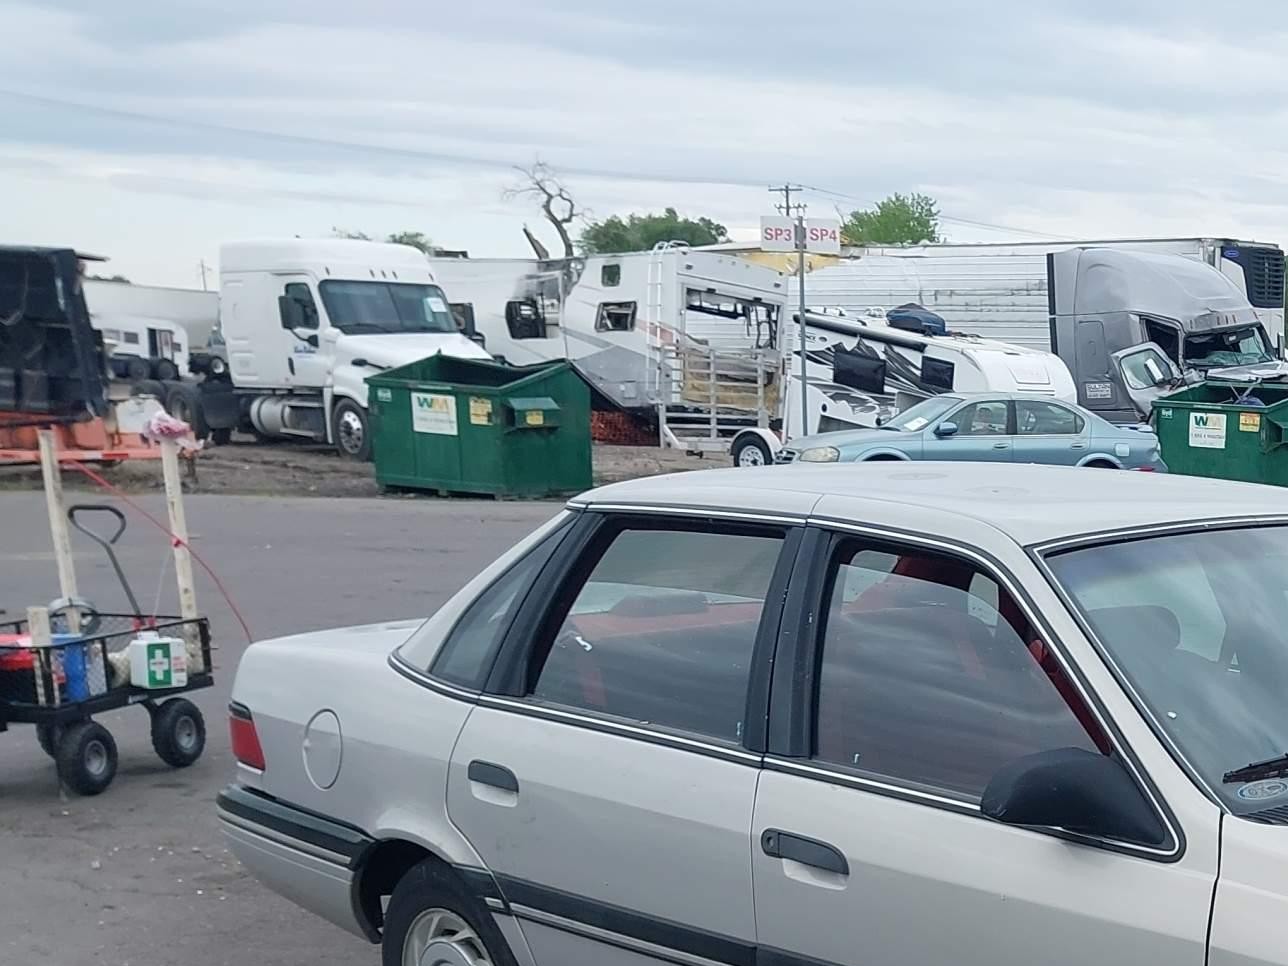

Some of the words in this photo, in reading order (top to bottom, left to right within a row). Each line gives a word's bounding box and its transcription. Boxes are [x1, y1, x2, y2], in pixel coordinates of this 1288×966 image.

[764, 227, 792, 241] SP3
[810, 228, 837, 241] SP4
[417, 396, 449, 410] WM
